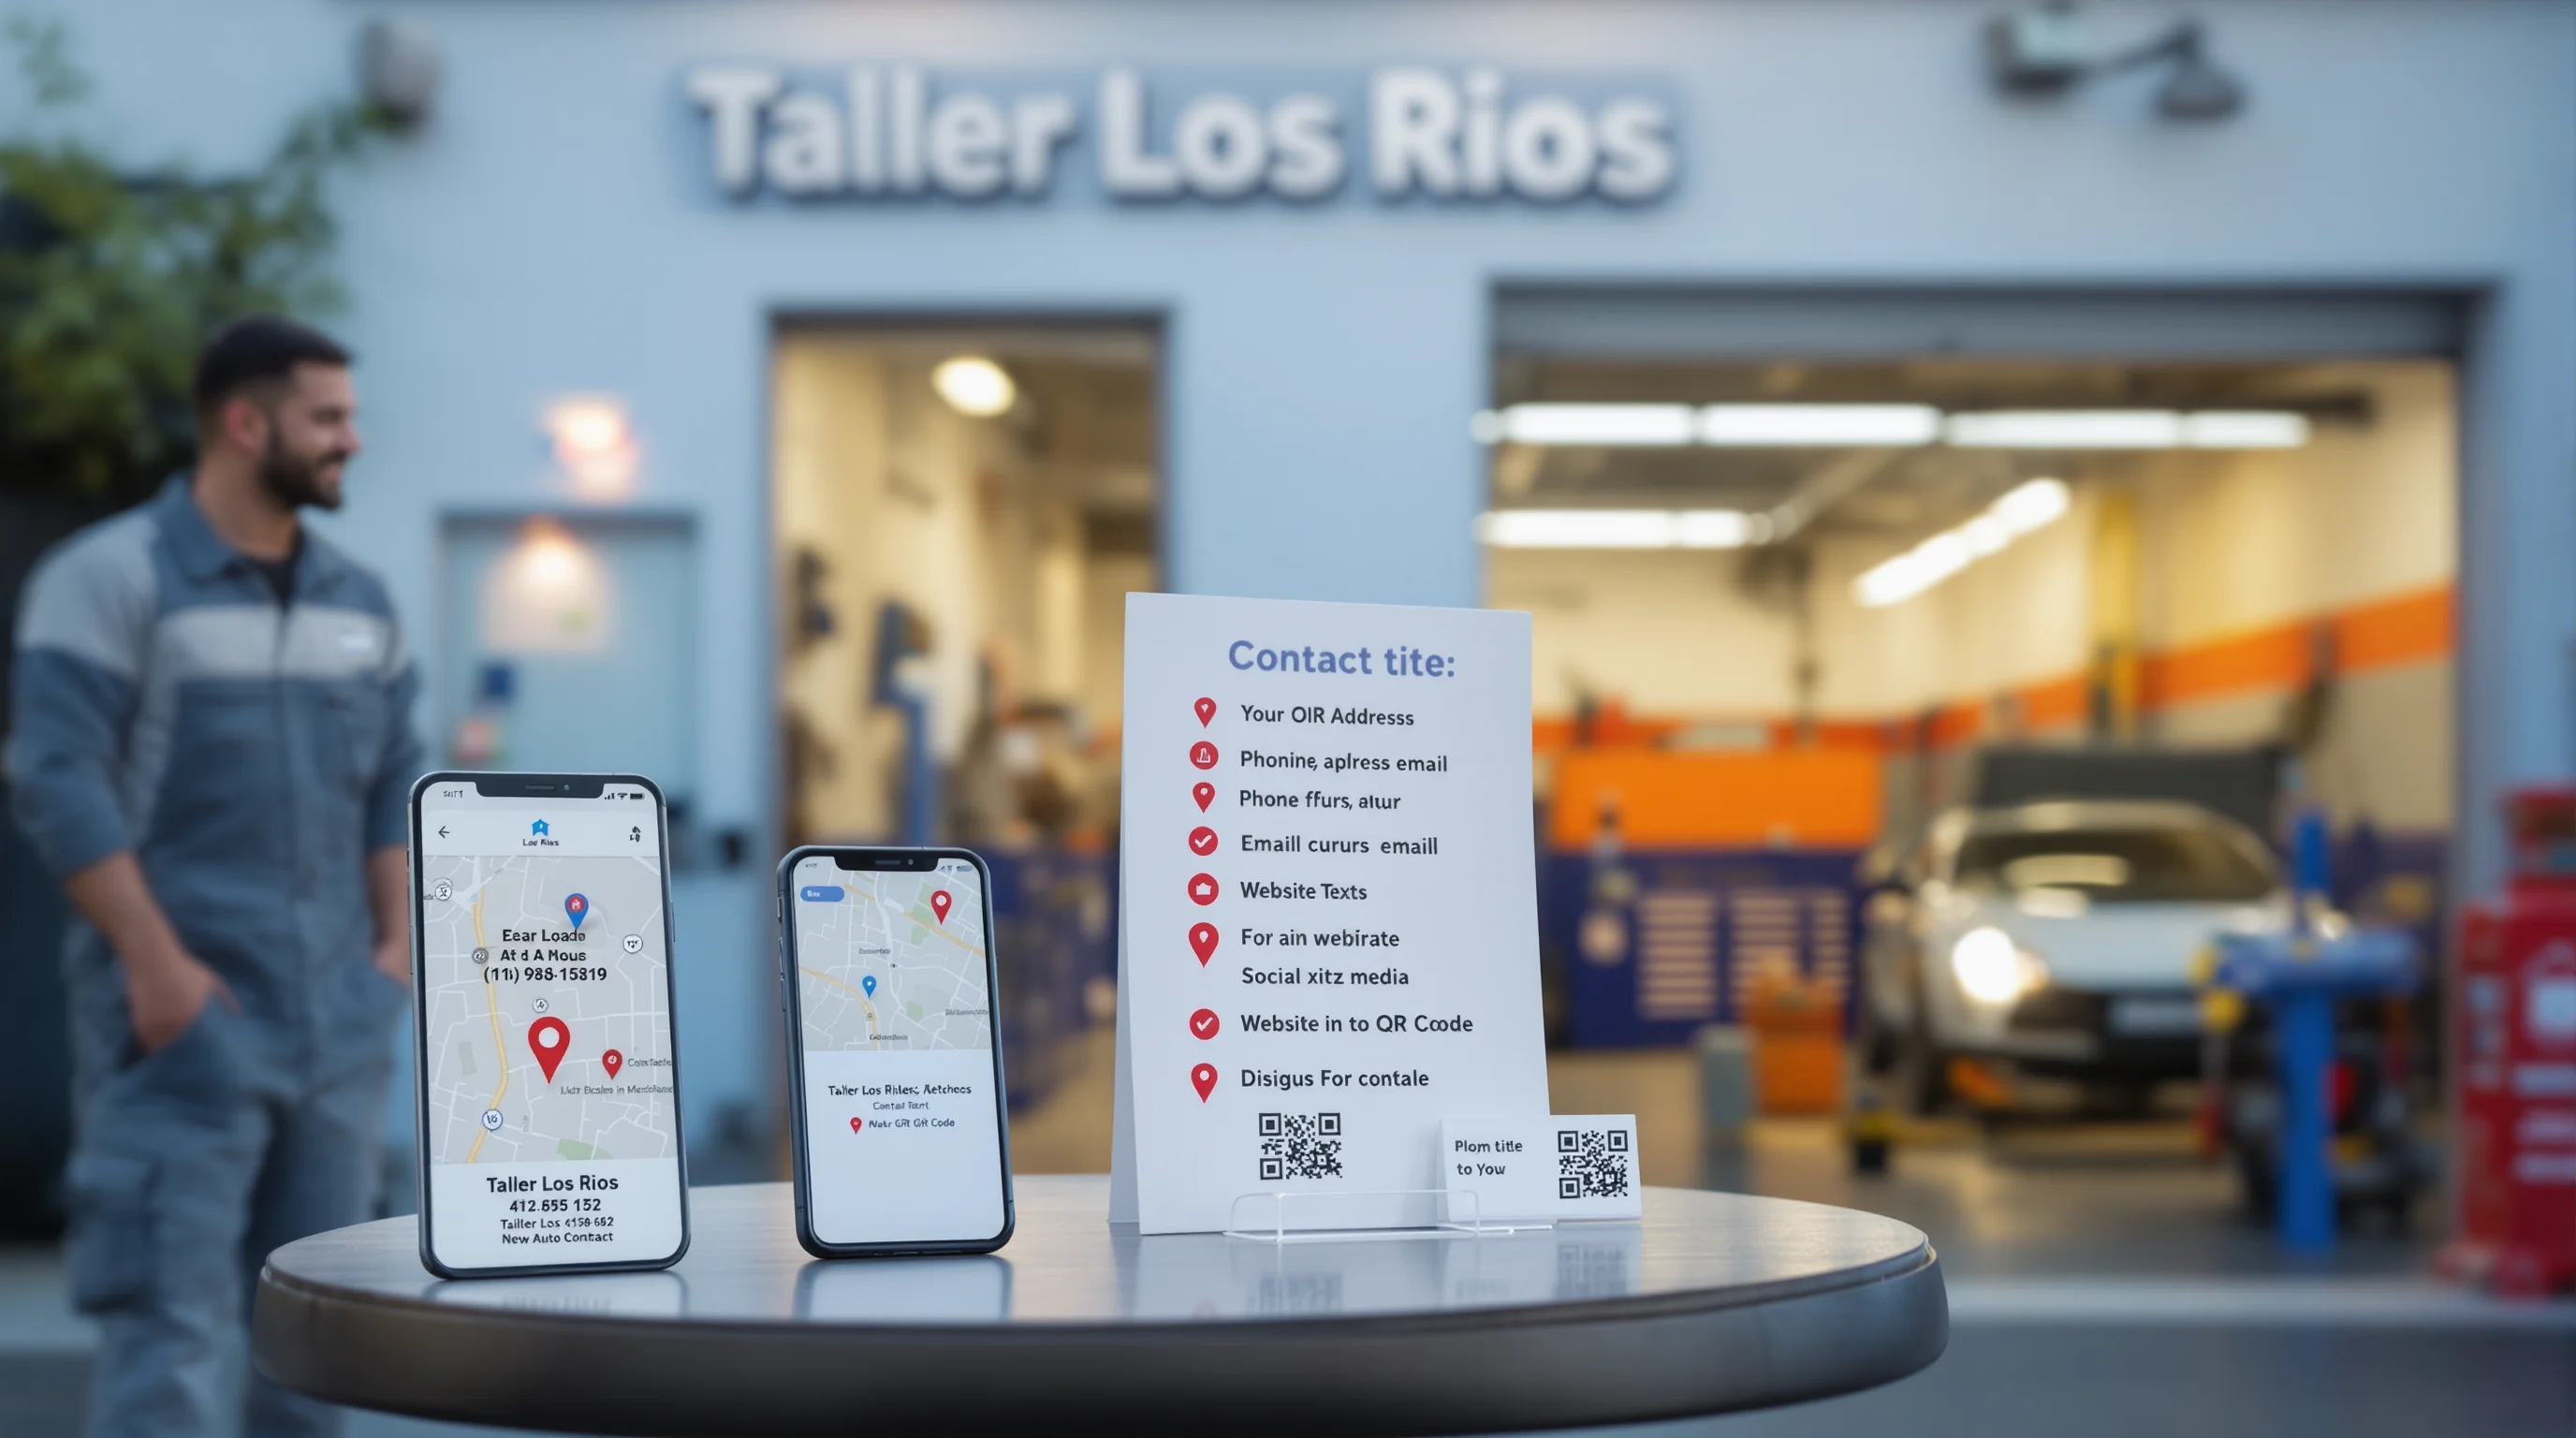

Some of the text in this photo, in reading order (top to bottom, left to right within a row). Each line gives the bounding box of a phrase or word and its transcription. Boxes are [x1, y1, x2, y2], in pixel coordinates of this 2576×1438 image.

[688, 66, 1677, 197] Taller Los Rios
[1228, 639, 1456, 678] Contact tite:
[1240, 705, 1285, 723] Your
[1330, 708, 1414, 726] Addresss
[1396, 755, 1448, 772] email
[1239, 789, 1299, 808] Phone
[1241, 834, 1301, 852] Emaill
[1380, 837, 1439, 855] emaill
[1240, 881, 1368, 901] Website Texts
[1241, 929, 1273, 946] For
[1279, 929, 1308, 946] ain
[533, 948, 545, 961] A
[1241, 966, 1410, 985] Social xitz media
[1240, 1014, 1320, 1033] Website
[1325, 1015, 1343, 1033] in
[1349, 1016, 1369, 1033] to
[1376, 1014, 1407, 1034] QR
[1321, 1069, 1352, 1087] For
[862, 1084, 882, 1095] Los
[930, 1117, 956, 1128] Code
[1456, 1163, 1472, 1176] to
[486, 1174, 619, 1193] Taller Los Rios
[502, 1233, 530, 1244] New
[533, 1233, 562, 1243] Auto
